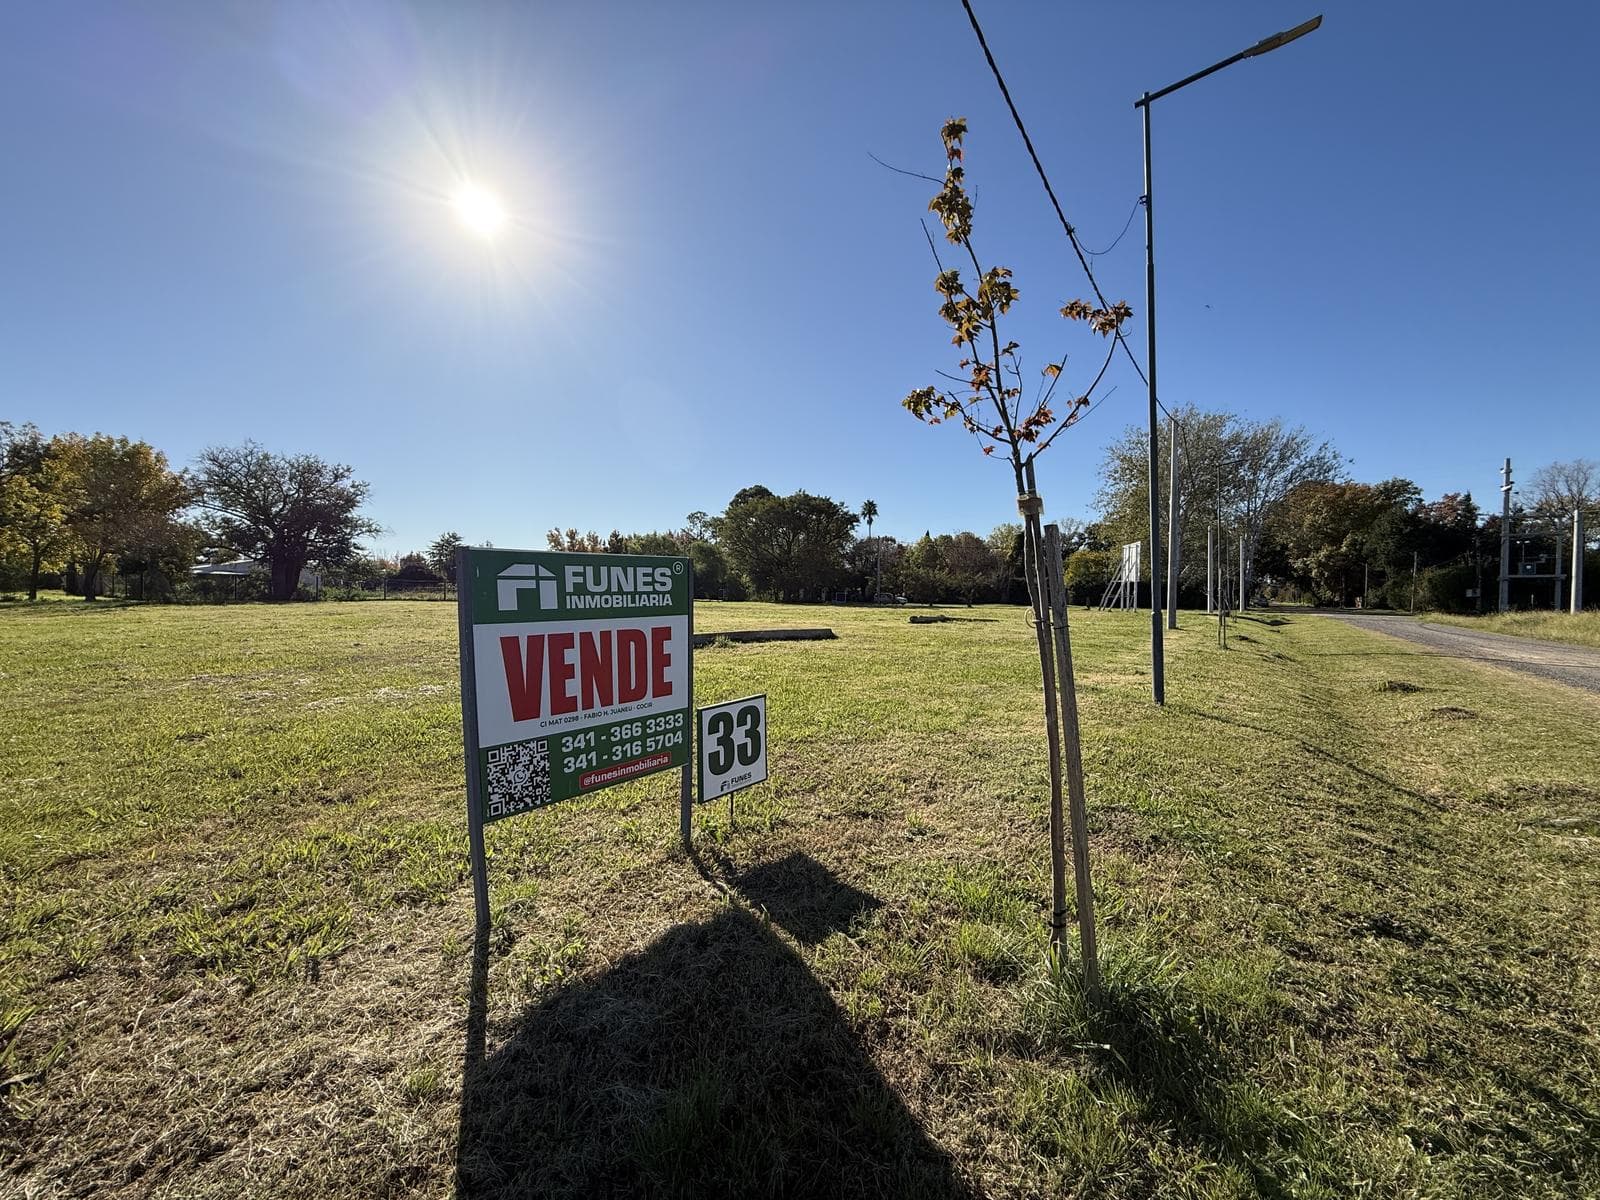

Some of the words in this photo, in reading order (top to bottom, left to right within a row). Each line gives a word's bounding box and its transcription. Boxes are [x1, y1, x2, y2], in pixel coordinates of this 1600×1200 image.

[564, 565, 673, 593] FUNES
[566, 593, 673, 609] INMOBILIARIA
[500, 626, 673, 721] VENDE
[549, 718, 563, 726] MAT
[584, 711, 602, 720] FABIO
[561, 731, 596, 753] 341
[610, 722, 642, 742] 366
[646, 713, 684, 734] 3333
[563, 751, 597, 773] 341
[612, 741, 642, 761] 316
[646, 730, 683, 752] 5704
[708, 705, 761, 776] 33
[583, 755, 669, 786] @funesinmobiliaria
[731, 771, 752, 784] FUNES
